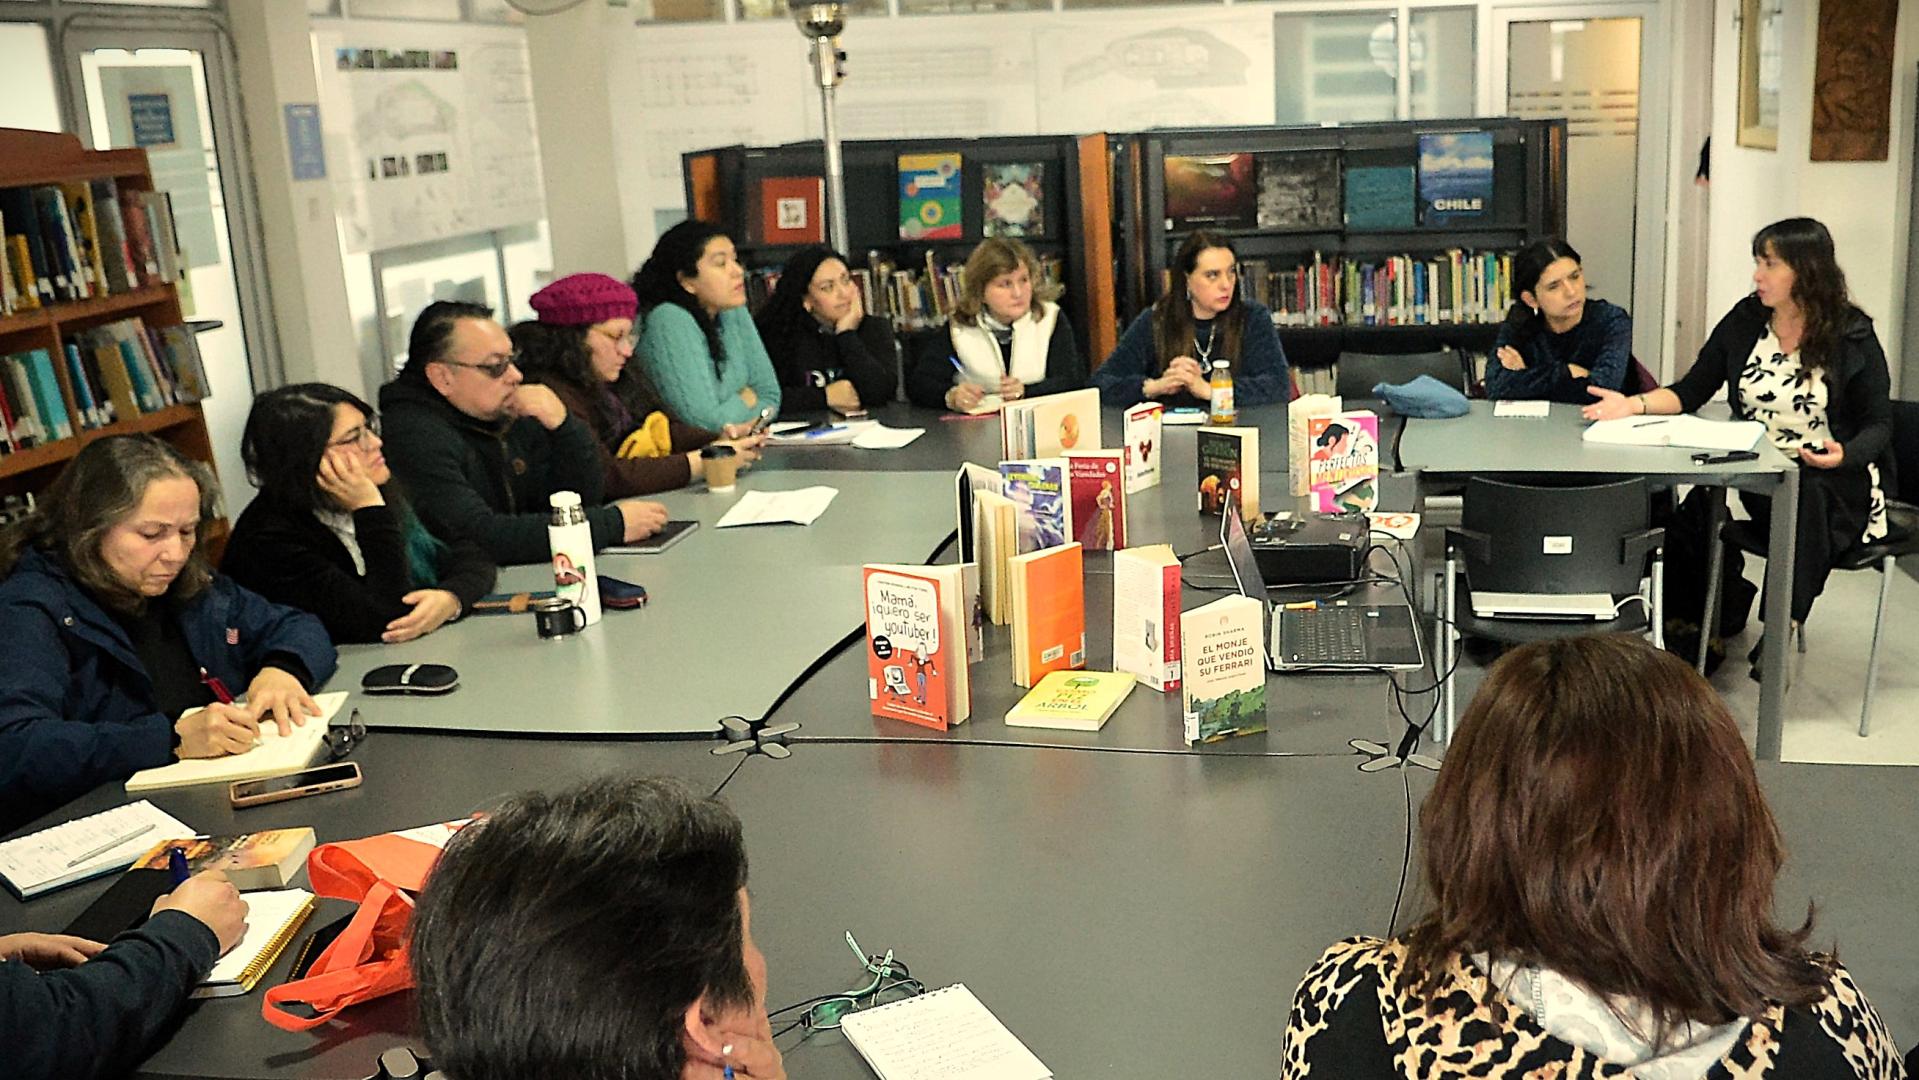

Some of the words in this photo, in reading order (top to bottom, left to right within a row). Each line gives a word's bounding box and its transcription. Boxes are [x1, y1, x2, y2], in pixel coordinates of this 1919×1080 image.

[1434, 199, 1482, 211] CHILE
[1319, 452, 1368, 472] PERFECTOS
[880, 590, 917, 608] Mamá,
[914, 611, 930, 623] ser
[885, 620, 936, 644] youtuber!
[1203, 645, 1213, 654] EL
[1216, 638, 1247, 651] MONJE
[1197, 655, 1216, 666] QUE
[1219, 646, 1254, 661] VENDIÓ
[1200, 667, 1211, 677] SU
[1213, 658, 1253, 673] FERRARI
